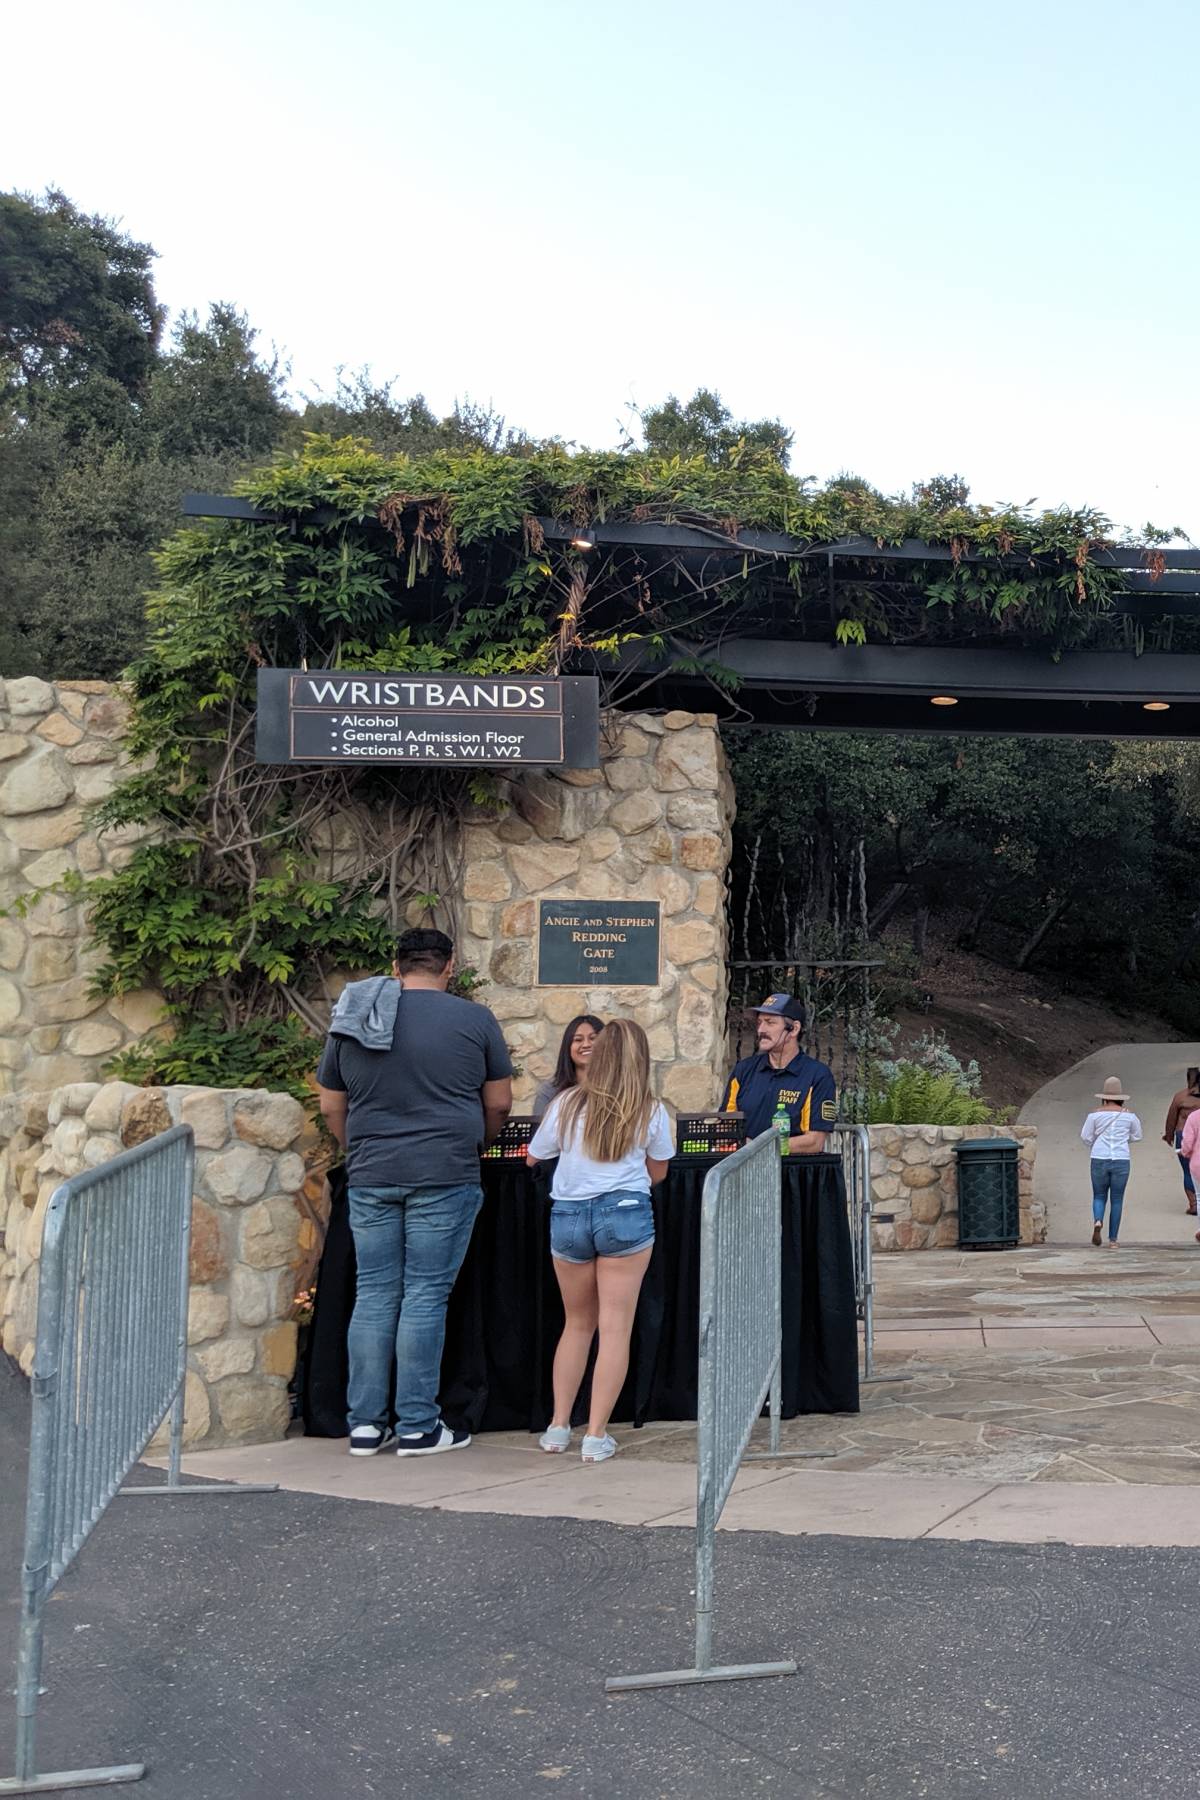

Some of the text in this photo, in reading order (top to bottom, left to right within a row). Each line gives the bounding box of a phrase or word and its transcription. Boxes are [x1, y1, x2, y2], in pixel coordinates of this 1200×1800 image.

[307, 680, 546, 709] WRISTBANDS
[340, 714, 399, 728] Alcohol
[342, 728, 525, 744] General Admission Floor
[342, 743, 405, 756] Sections
[409, 744, 420, 758] P,
[425, 744, 440, 758] R,
[444, 744, 457, 758] S,
[493, 746, 522, 758] W2
[544, 915, 655, 927] ANGIE AND STEPHEN
[572, 931, 627, 943] REDDING
[583, 947, 615, 959] GATE
[589, 965, 608, 973] 2008
[779, 1088, 801, 1098] EVENT
[777, 1096, 798, 1105] STAFF
